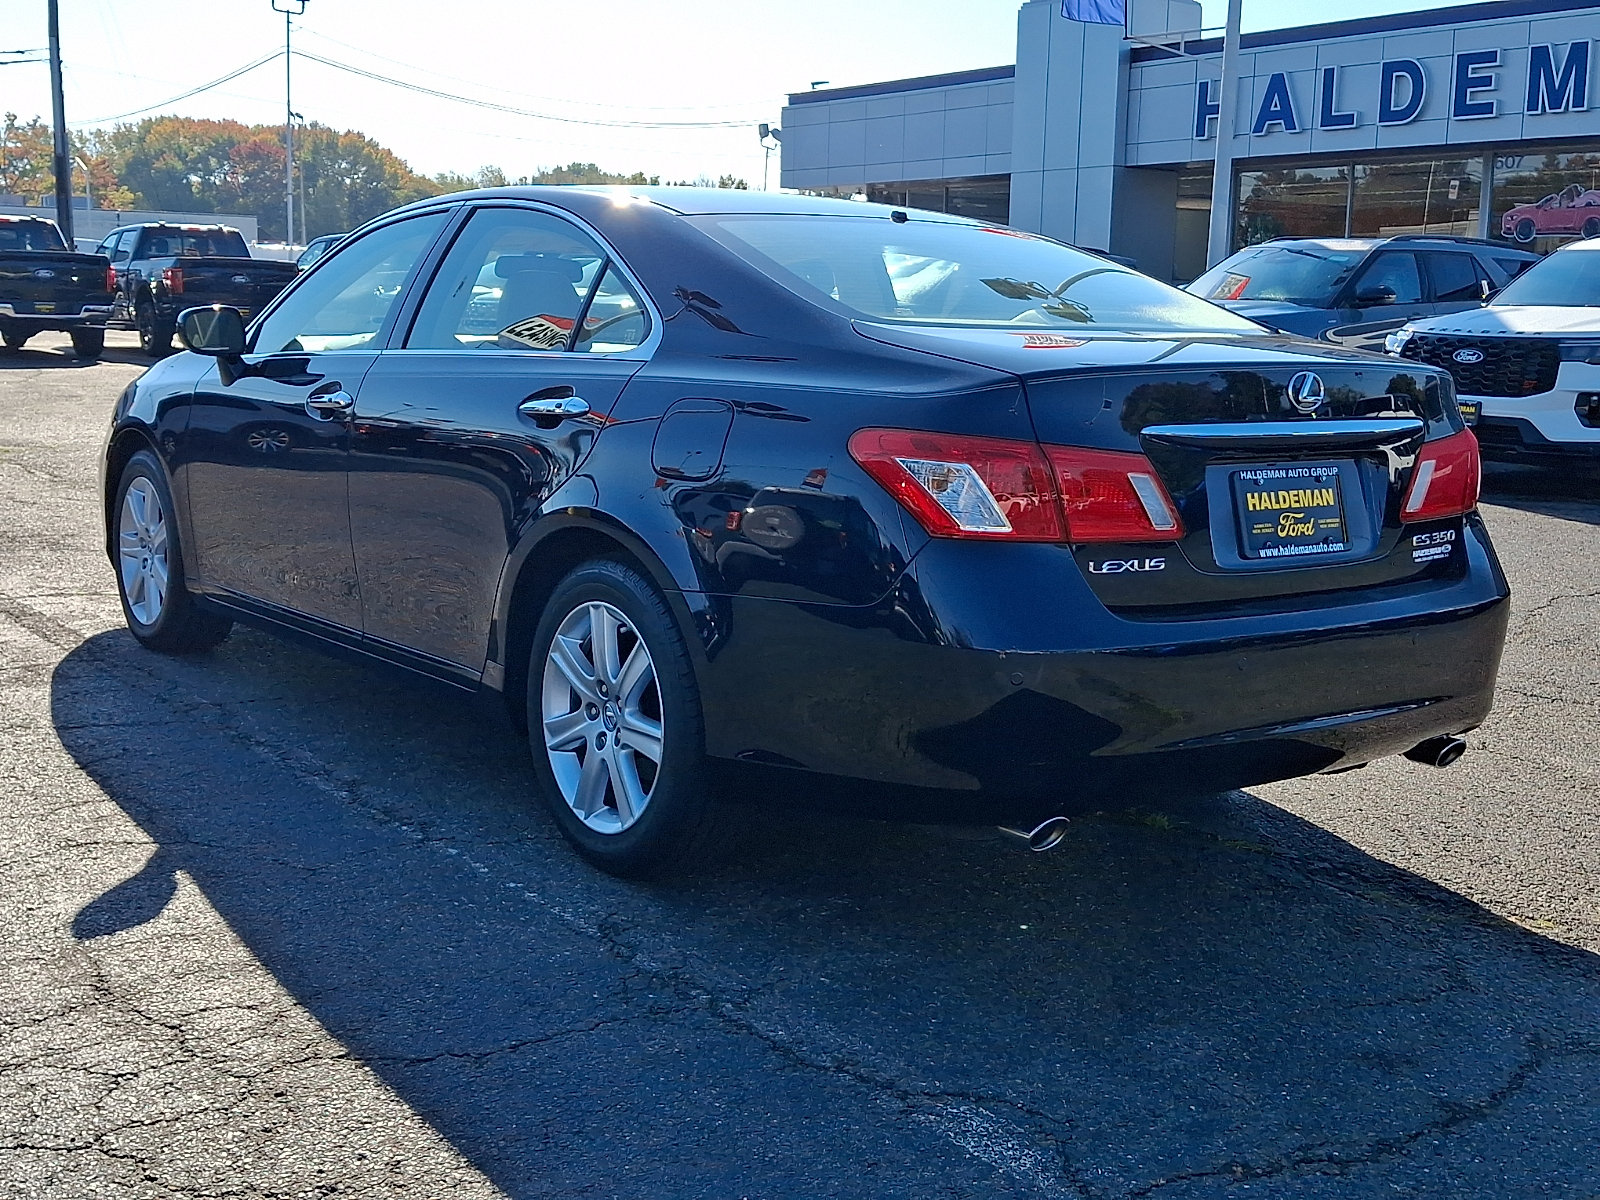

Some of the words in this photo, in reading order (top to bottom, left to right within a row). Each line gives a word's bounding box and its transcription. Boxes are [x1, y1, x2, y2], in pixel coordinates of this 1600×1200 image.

[1194, 38, 1592, 140] HALDEM
[1456, 350, 1480, 361] Ford
[1240, 469, 1286, 480] HALDEMAN
[1288, 468, 1309, 478] AUTO
[1310, 466, 1338, 477] GROUP
[1246, 488, 1335, 511] HALDEMAN
[1277, 512, 1315, 537] Ford
[1412, 533, 1431, 547] ES
[1431, 529, 1456, 544] 350
[1258, 542, 1344, 558] www.haldemanauto.com
[1088, 557, 1166, 574] LEXUS
